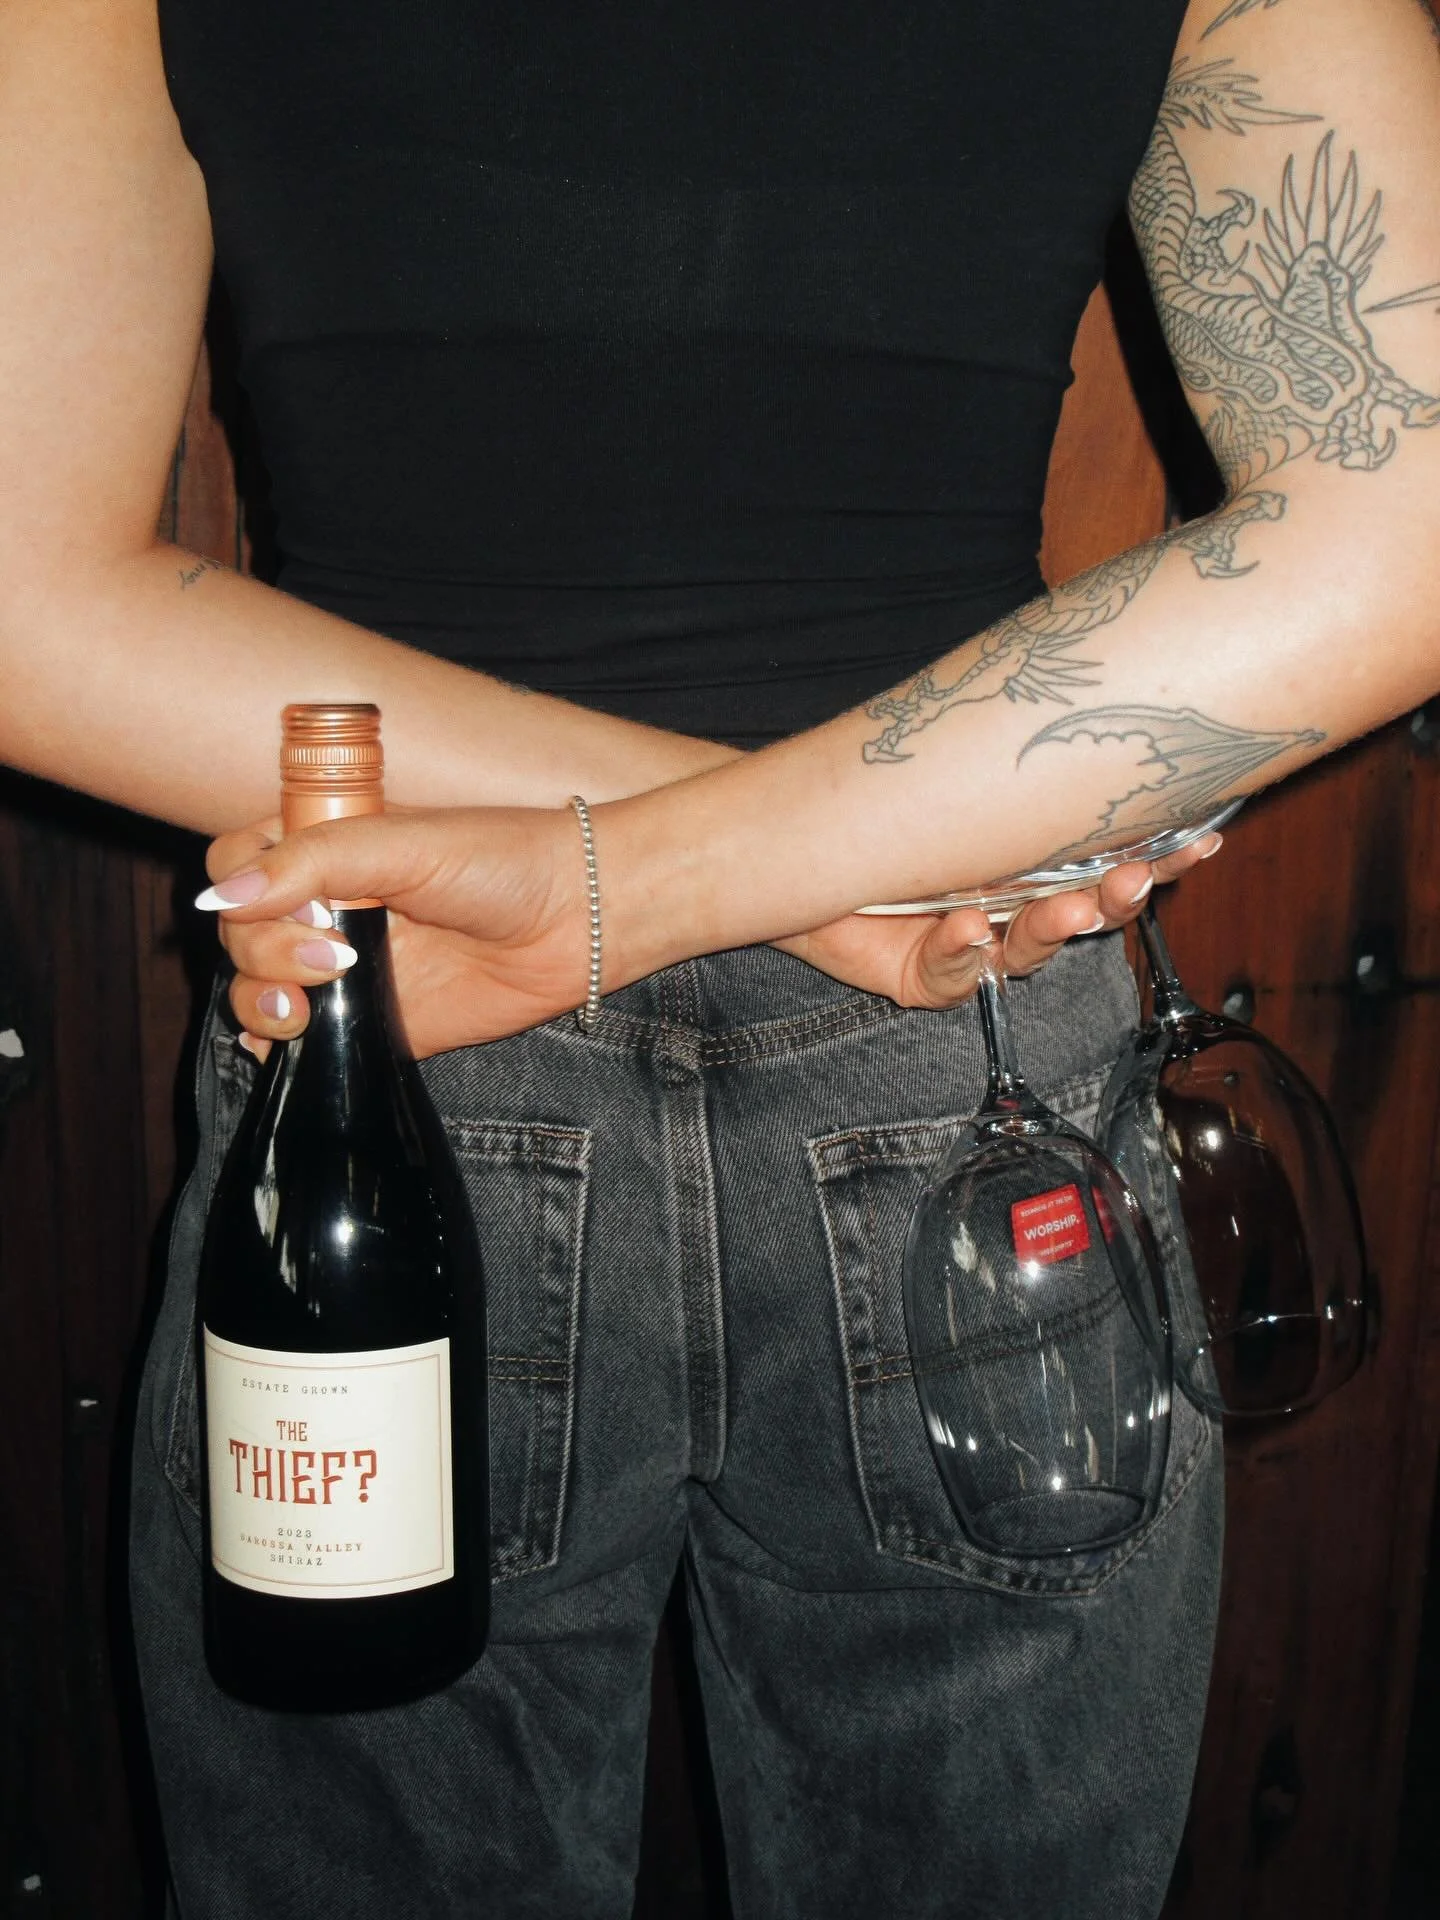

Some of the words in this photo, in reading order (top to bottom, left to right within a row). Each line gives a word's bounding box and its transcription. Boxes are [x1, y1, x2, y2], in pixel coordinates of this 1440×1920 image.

[1024, 1214, 1080, 1240] WORSHIP.
[242, 1378, 289, 1392] ESTATE
[302, 1385, 348, 1395] GROWN
[276, 1420, 307, 1441] THE
[228, 1438, 378, 1504] THIEF?
[277, 1528, 312, 1538] 2023
[306, 1543, 363, 1552] VALLEY
[270, 1554, 323, 1566] SHIRAZ
